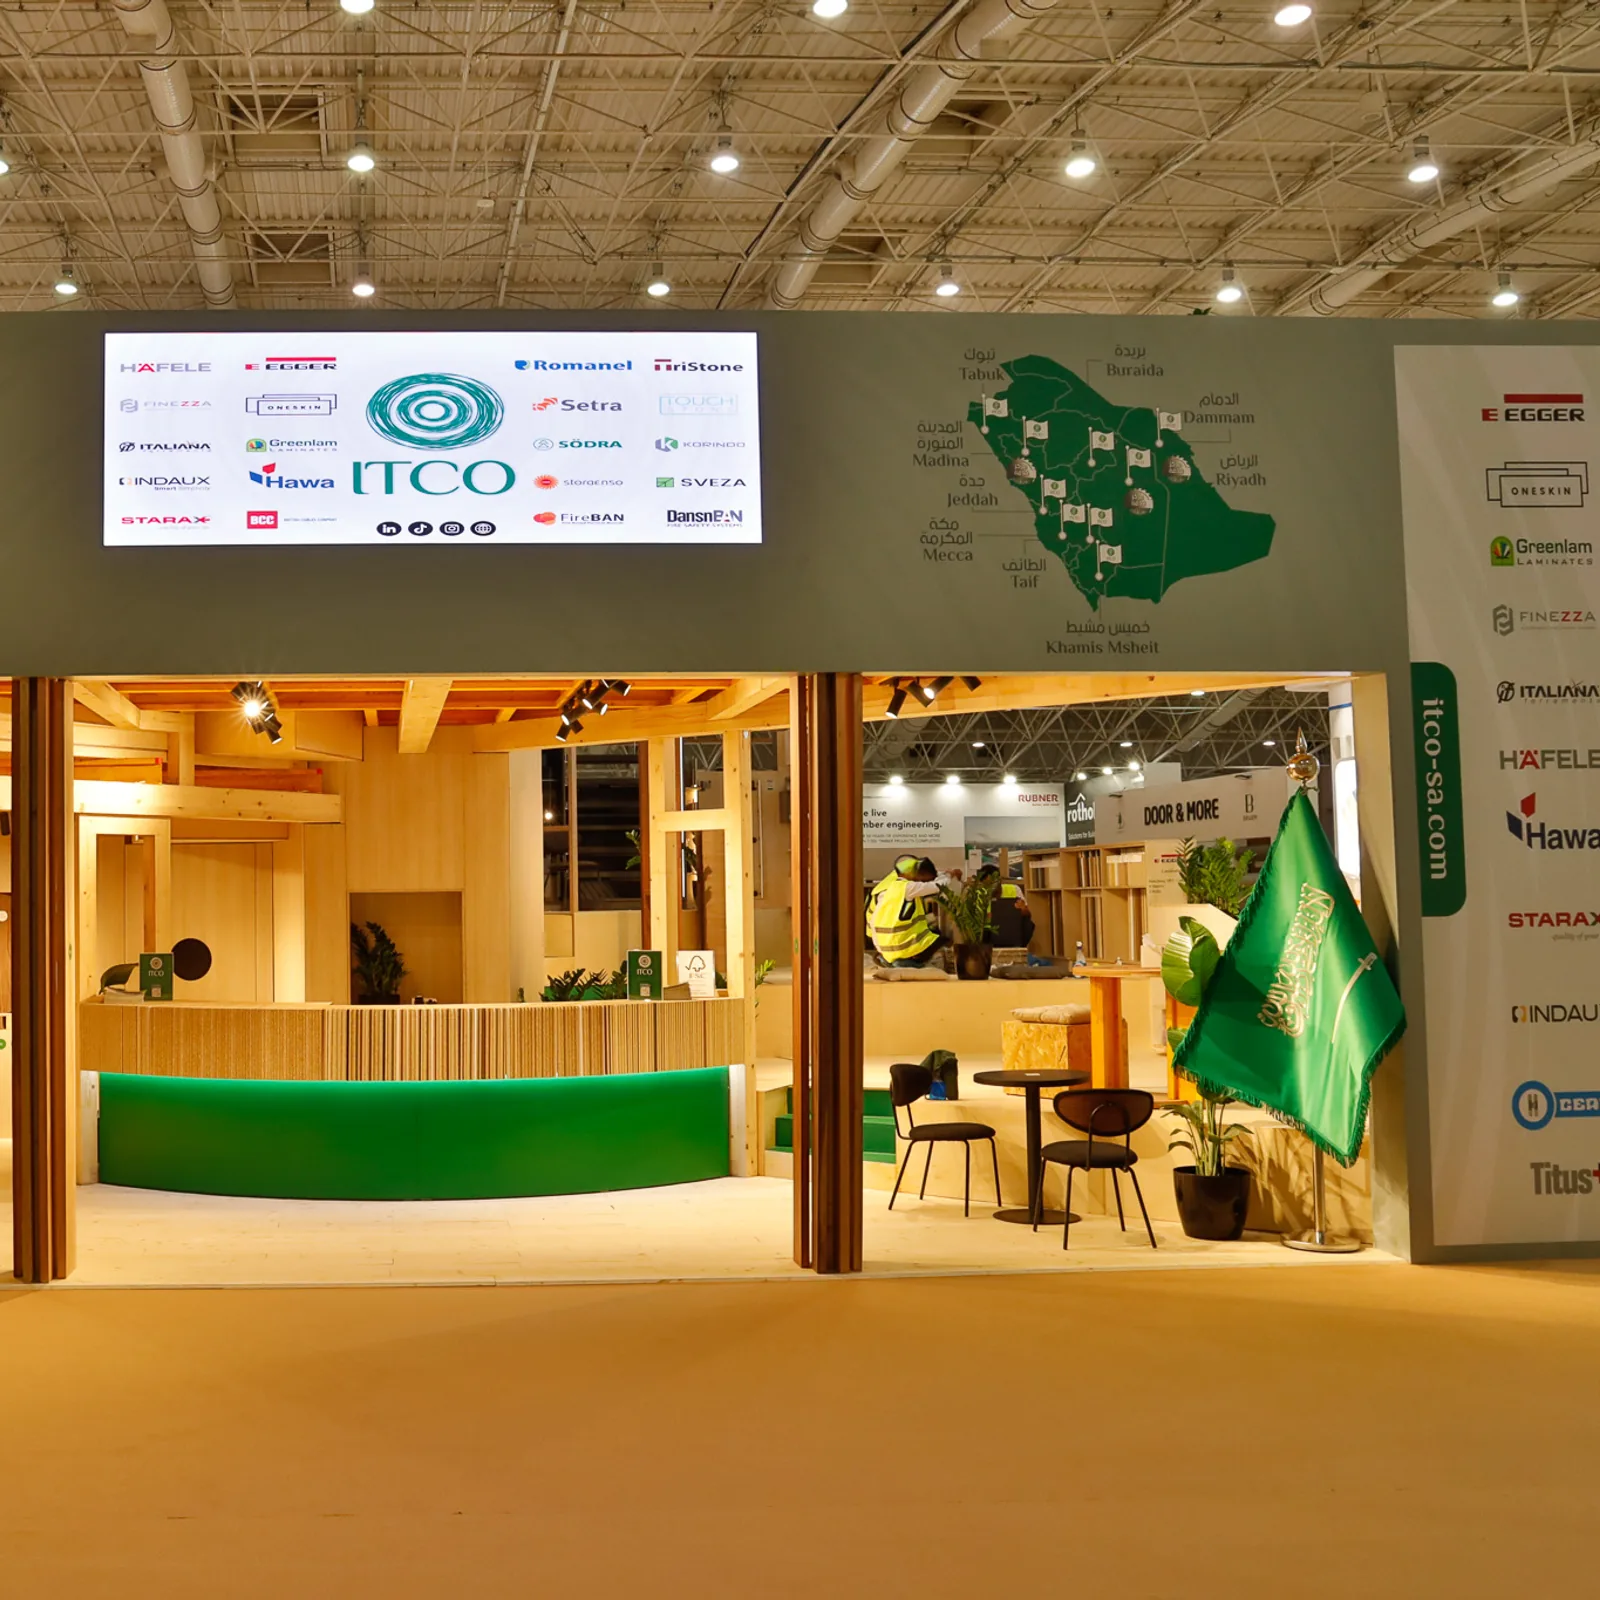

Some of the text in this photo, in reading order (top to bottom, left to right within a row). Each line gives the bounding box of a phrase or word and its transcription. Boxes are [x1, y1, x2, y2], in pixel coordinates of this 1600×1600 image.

[963, 346, 996, 363] تبوك
[1114, 344, 1146, 359] بريدة
[120, 363, 211, 373] HÄFELE
[266, 363, 338, 371] EGGER
[534, 359, 632, 371] Romanel
[1106, 363, 1164, 377] Buraida
[959, 367, 1005, 381] Tabuk
[560, 399, 623, 411] Setra
[1199, 391, 1239, 408] الدمام
[1183, 410, 1255, 424] Dammam
[1504, 408, 1585, 422] EGGER
[917, 420, 963, 436] المدينة
[269, 438, 338, 447] Greenlam
[558, 438, 623, 448] SÖDRA
[917, 436, 964, 452] المنورة
[912, 453, 969, 467] Madina
[1220, 451, 1259, 470] الرياض
[134, 476, 211, 486] INDAUX
[265, 475, 335, 489] Hawa
[353, 460, 516, 496] ITCO
[681, 478, 746, 487] SVEZA
[959, 473, 985, 490] جدة
[1216, 472, 1266, 490] Riyadh
[1511, 487, 1571, 496] ONESKIN
[947, 492, 999, 508] Jeddah
[121, 516, 211, 524] STARAX
[250, 515, 275, 525] BCC
[560, 513, 625, 522] FireBAN
[929, 516, 959, 531] مكة
[919, 531, 973, 547] المكرمة
[1516, 538, 1593, 554] Greenlam
[923, 548, 973, 562] Mecca
[1002, 558, 1047, 571] الطائف
[1010, 575, 1040, 588] Taif
[1519, 611, 1597, 622] FINEZZA
[1066, 618, 1151, 637] خميس مشيط
[1046, 640, 1159, 654] Khamis Msheit
[1520, 685, 1599, 698] ITALIANA
[1499, 749, 1600, 770] HÄFELE
[1422, 698, 1447, 880] itco-sa.com
[1018, 794, 1059, 803] RUBNER
[871, 808, 887, 817] live
[1144, 798, 1220, 826] DOOR & MORE
[886, 820, 943, 830] engineering.
[1526, 822, 1600, 850] Hawa
[636, 968, 653, 976] ITCO
[1530, 1003, 1600, 1023] INDAU
